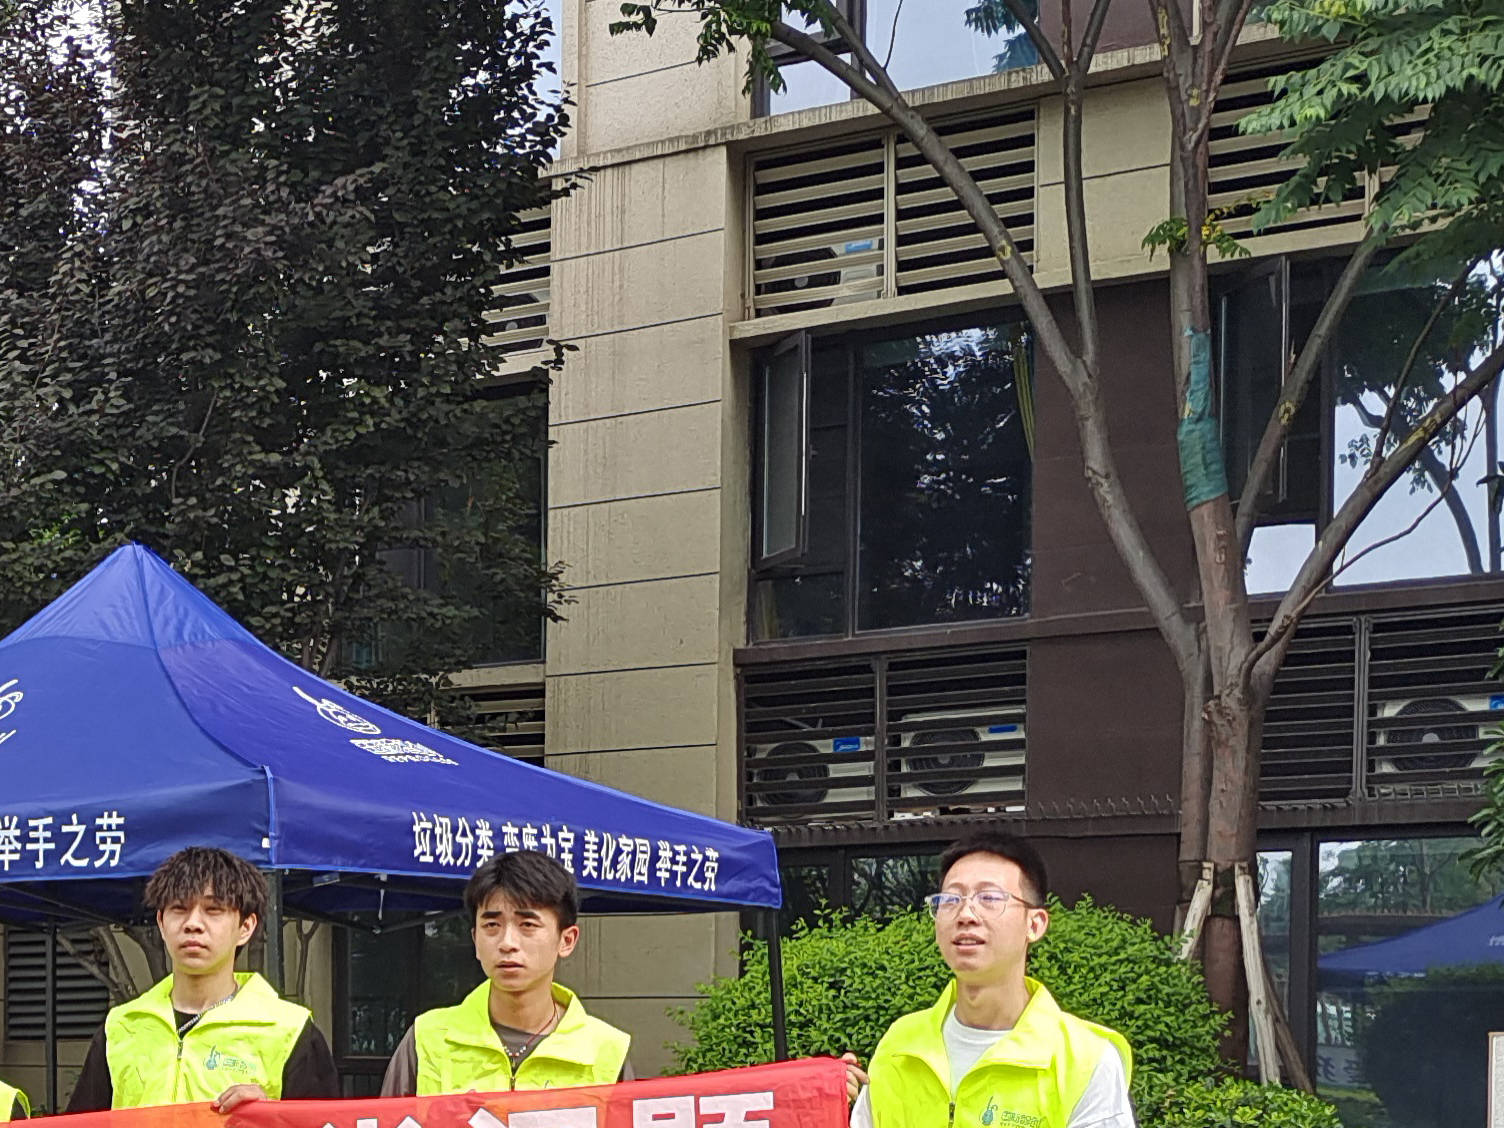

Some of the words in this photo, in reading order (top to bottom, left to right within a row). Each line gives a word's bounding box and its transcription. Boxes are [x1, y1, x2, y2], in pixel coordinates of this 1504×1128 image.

[412, 811, 494, 868] 垃圾分类
[582, 829, 651, 885] 美化家园
[655, 839, 719, 892] 举手之劳
